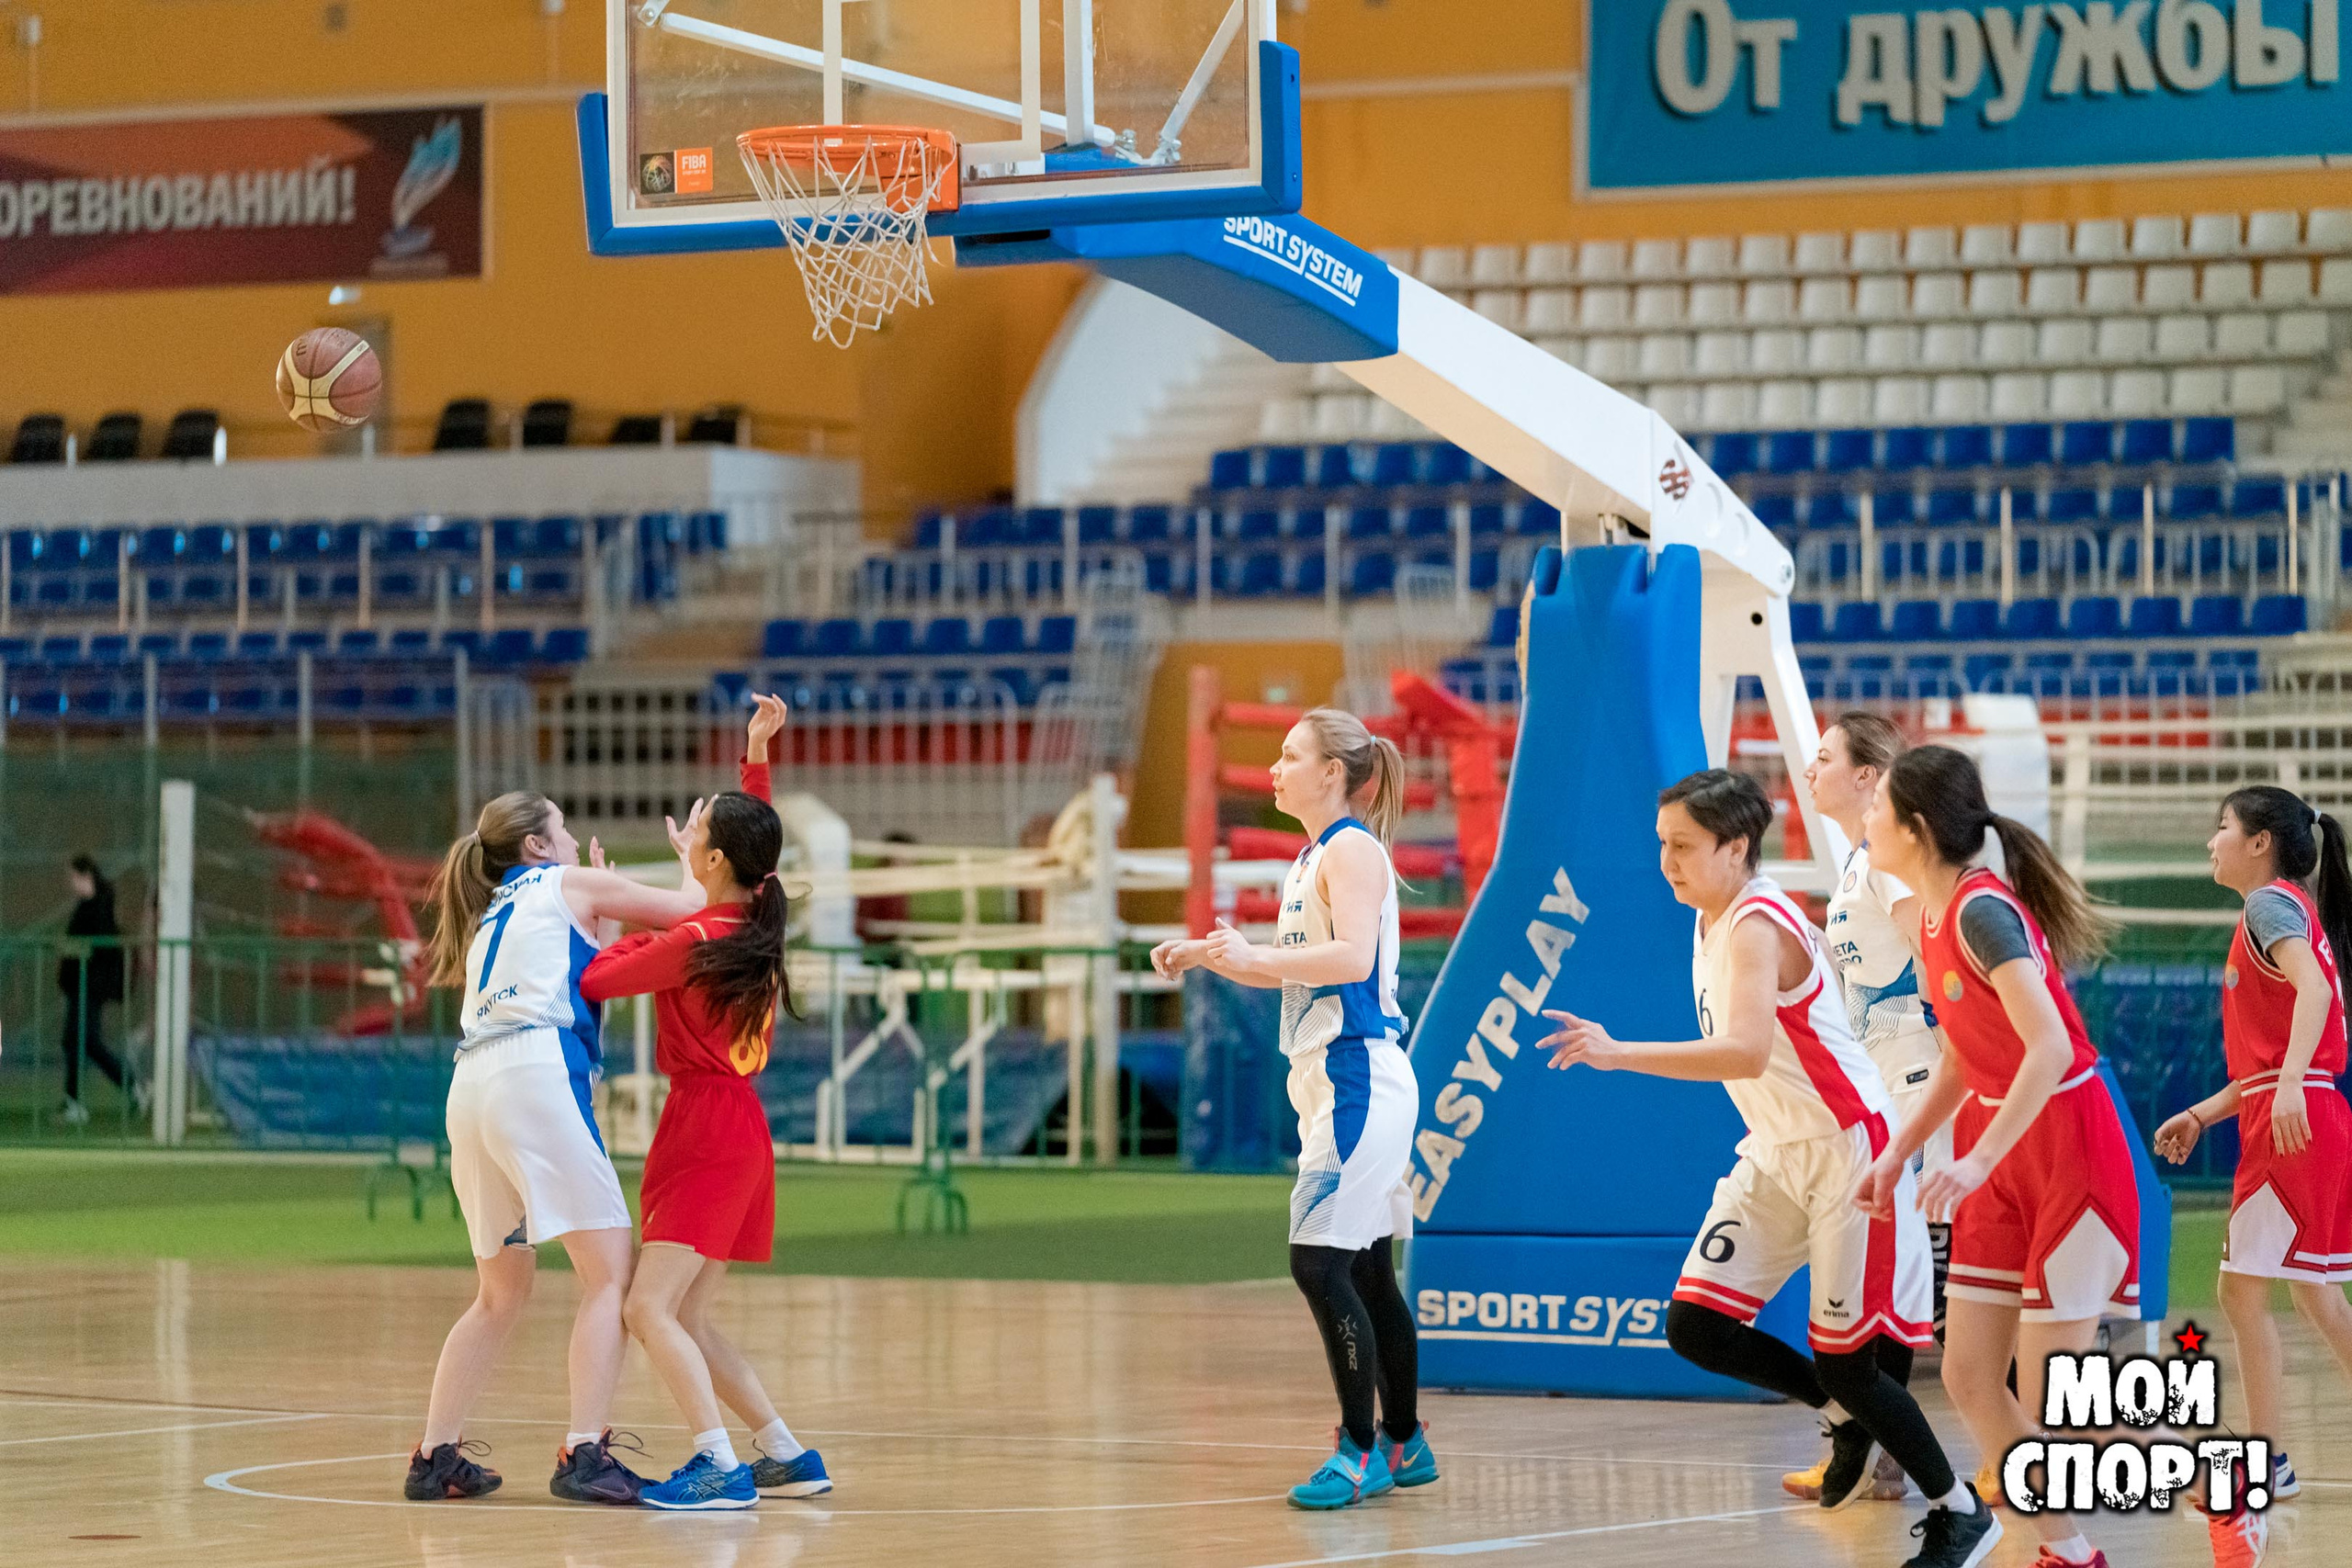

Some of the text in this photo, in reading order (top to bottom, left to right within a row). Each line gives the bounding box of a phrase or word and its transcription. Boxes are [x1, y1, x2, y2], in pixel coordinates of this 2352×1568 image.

[1657, 0, 2339, 127] От дружбы
[682, 154, 707, 170] FIBA
[1224, 217, 1363, 299] SPORT SYSTEM
[1282, 931, 1307, 947] ЕТА
[477, 984, 518, 1021] ЯКУТСК
[1699, 988, 1713, 1037] 6
[1406, 866, 1590, 1223] EASYPLAY
[1700, 1220, 1742, 1264] 6
[1418, 1290, 1566, 1330] SPORT
[1823, 1309, 1849, 1318] erima
